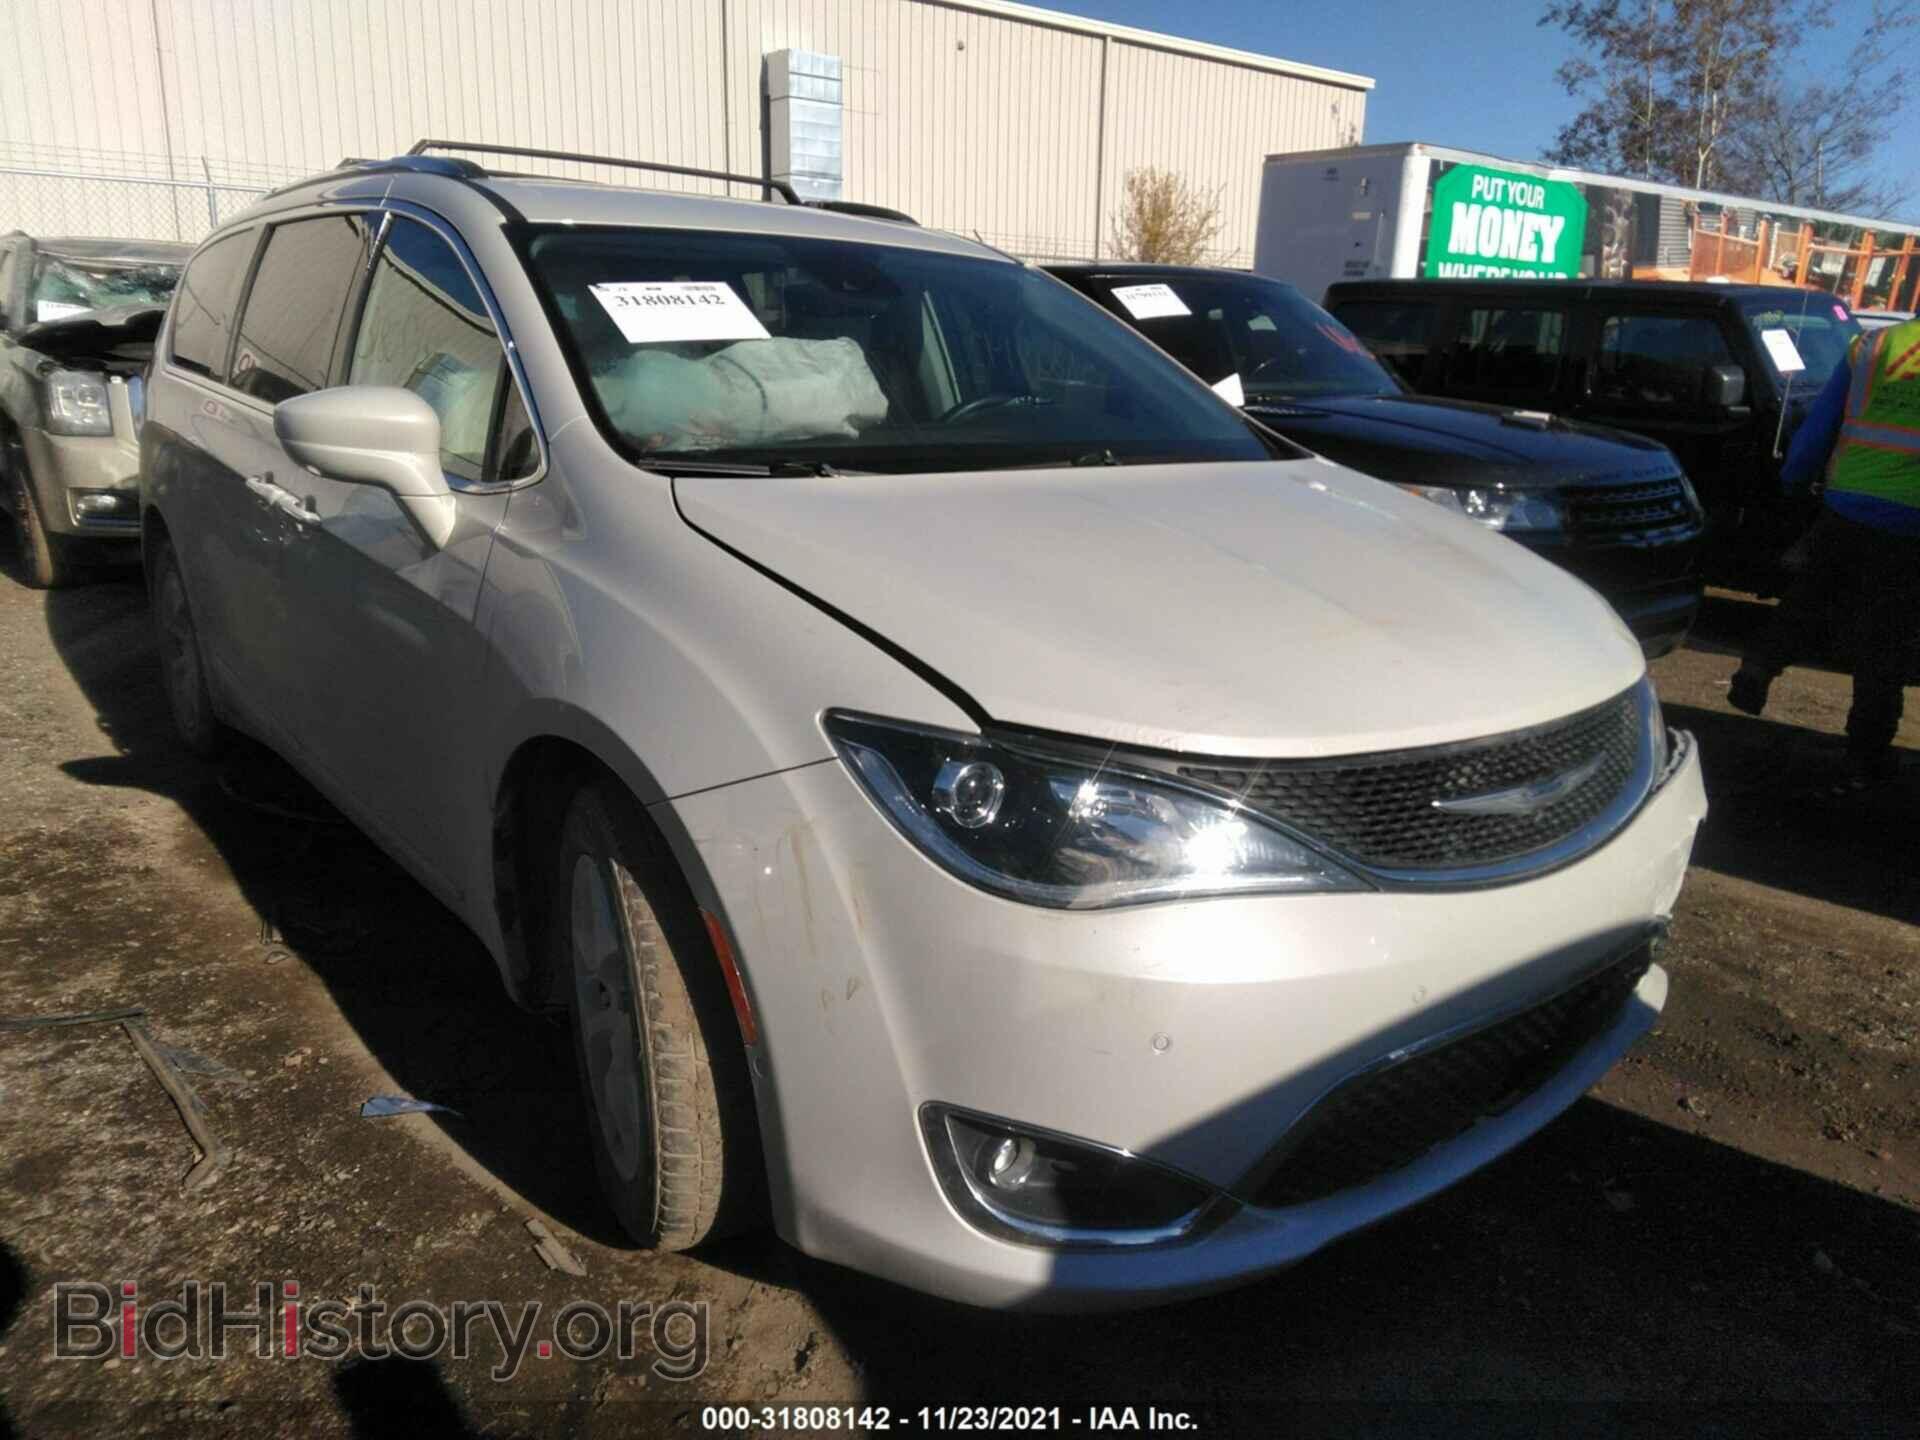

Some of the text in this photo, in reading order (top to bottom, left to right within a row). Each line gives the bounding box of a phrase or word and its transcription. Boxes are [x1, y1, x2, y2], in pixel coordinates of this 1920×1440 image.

[1472, 174, 1545, 209] PUT YOUR
[1448, 201, 1566, 263] MONEY
[614, 294, 725, 307] 31808142
